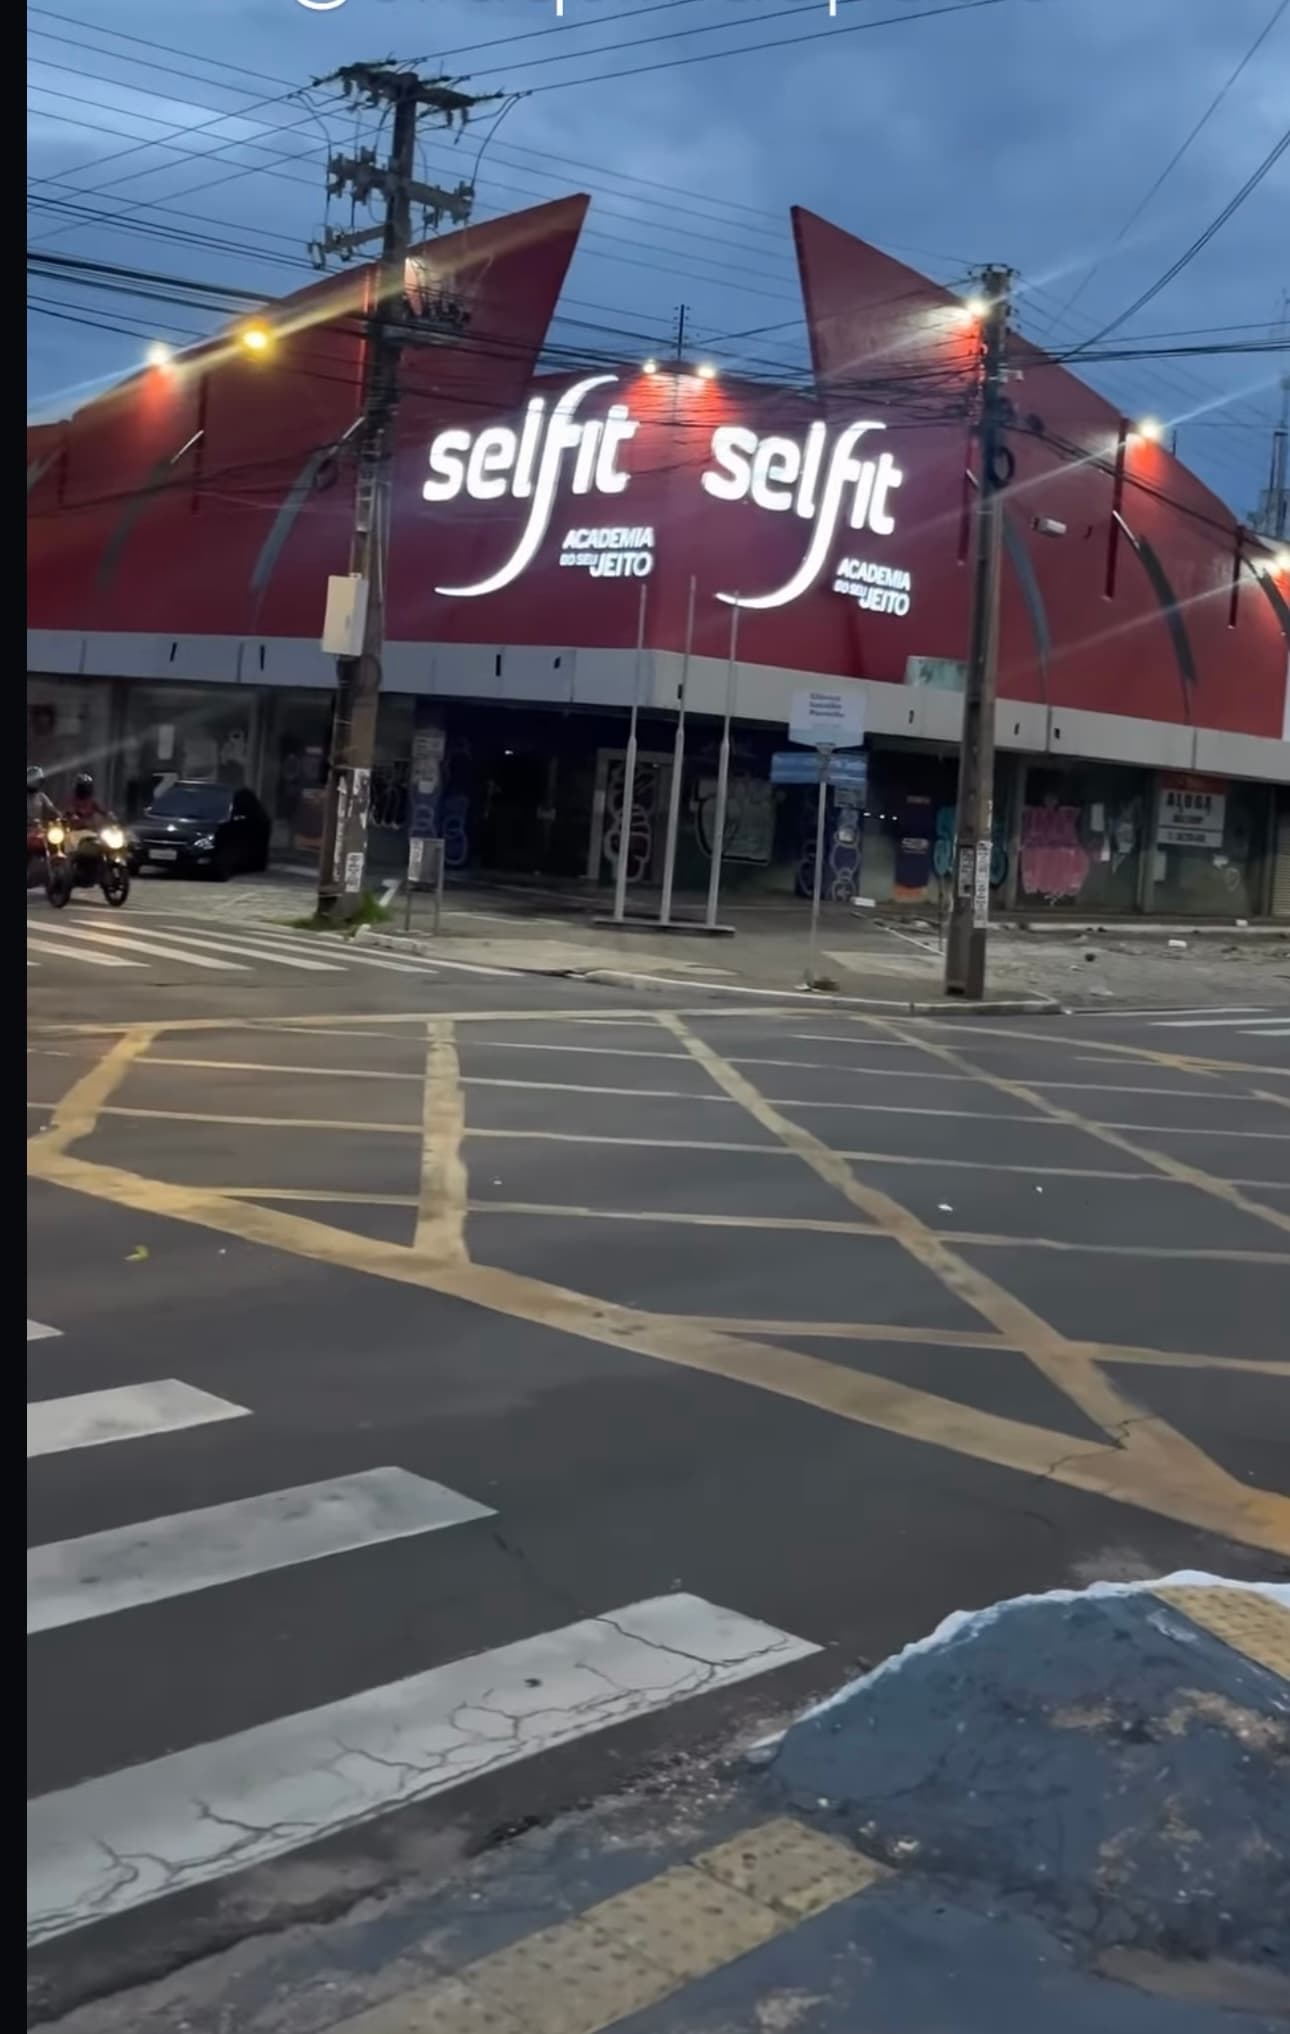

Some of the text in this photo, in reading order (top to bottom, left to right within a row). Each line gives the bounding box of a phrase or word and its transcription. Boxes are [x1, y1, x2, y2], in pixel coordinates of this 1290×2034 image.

[423, 375, 640, 596] selfit
[702, 421, 903, 609] selfit
[562, 527, 655, 549] ACADEMIA
[589, 551, 653, 577] JEITO
[836, 558, 911, 591] ACADEMIA
[858, 587, 910, 616] JEITO
